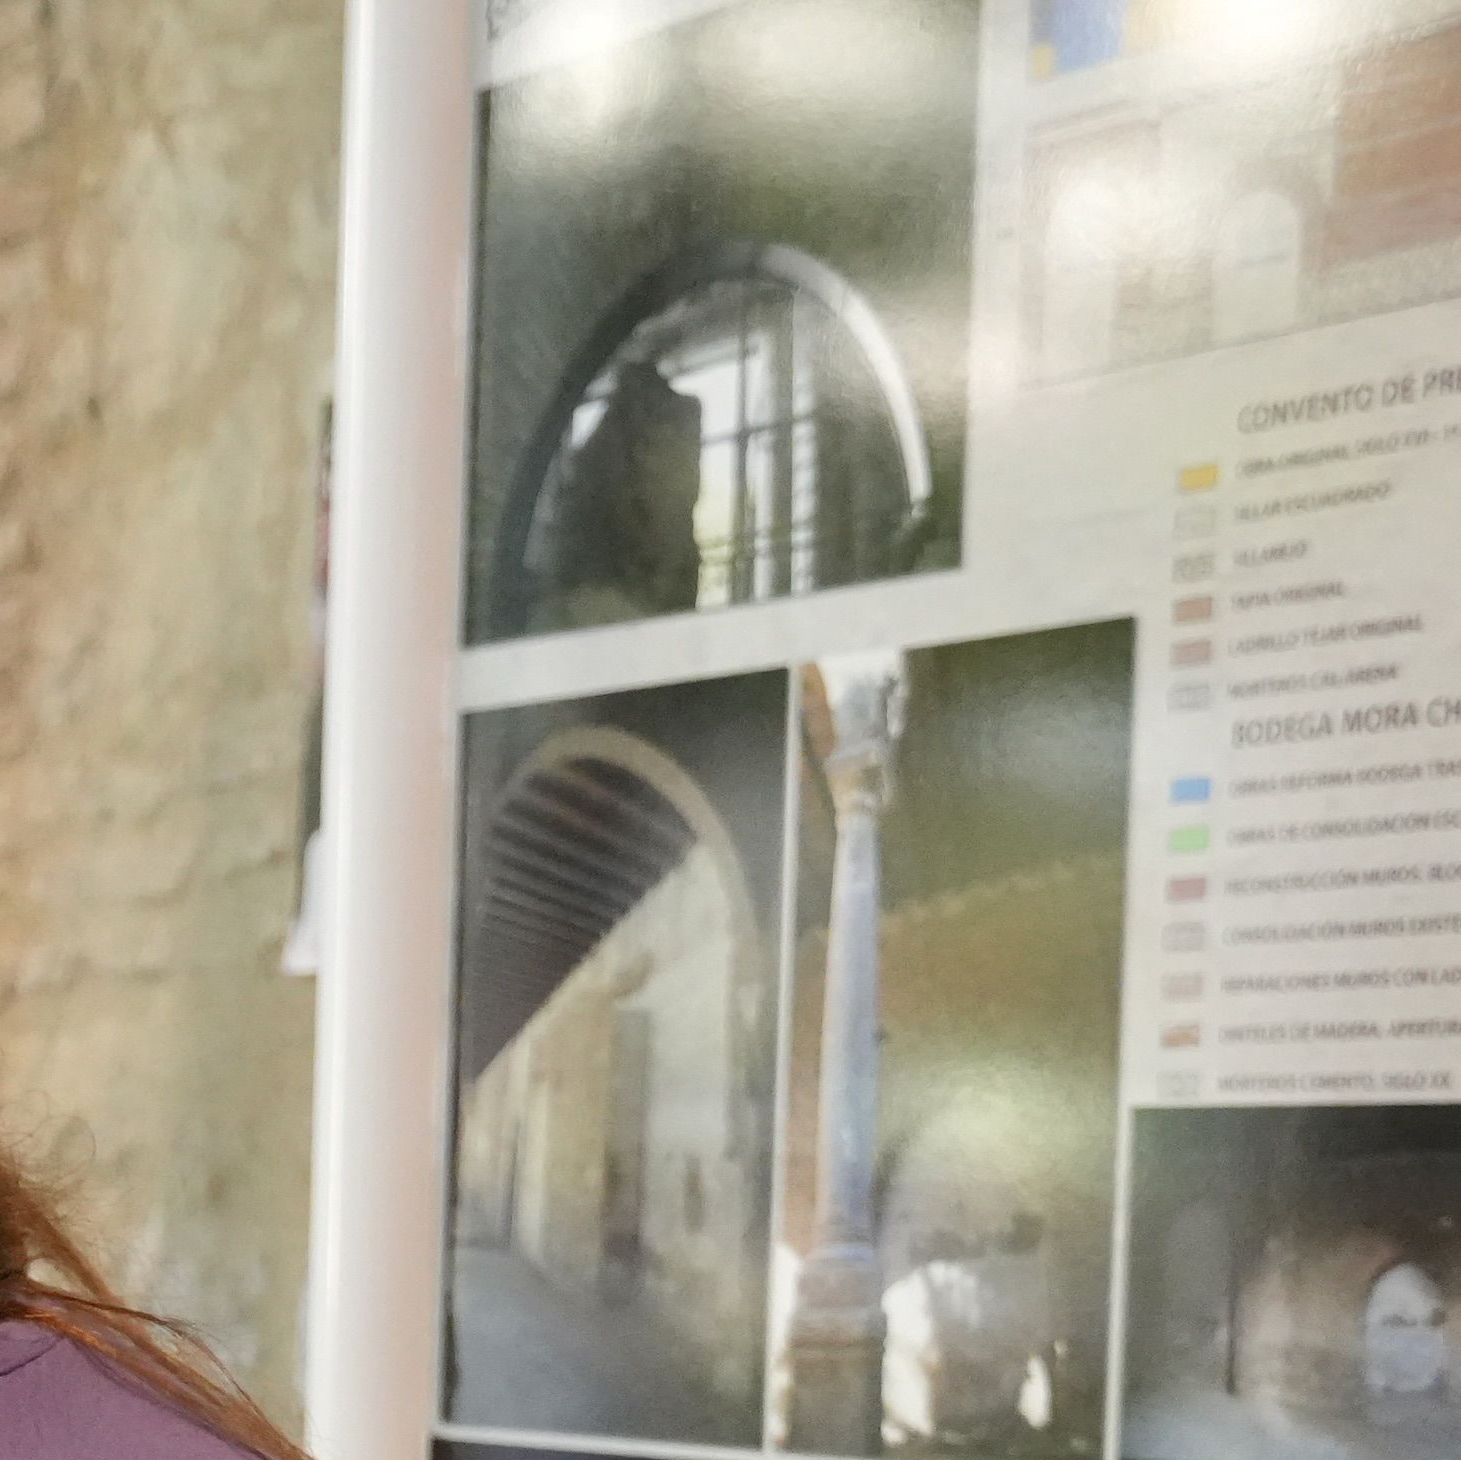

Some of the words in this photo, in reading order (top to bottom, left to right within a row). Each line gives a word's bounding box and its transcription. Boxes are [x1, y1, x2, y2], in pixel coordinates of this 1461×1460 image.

[1236, 382, 1374, 435] CONVENTO
[1381, 374, 1416, 408] DE
[1231, 711, 1334, 750] BODEGA
[1340, 701, 1418, 737] MORA
